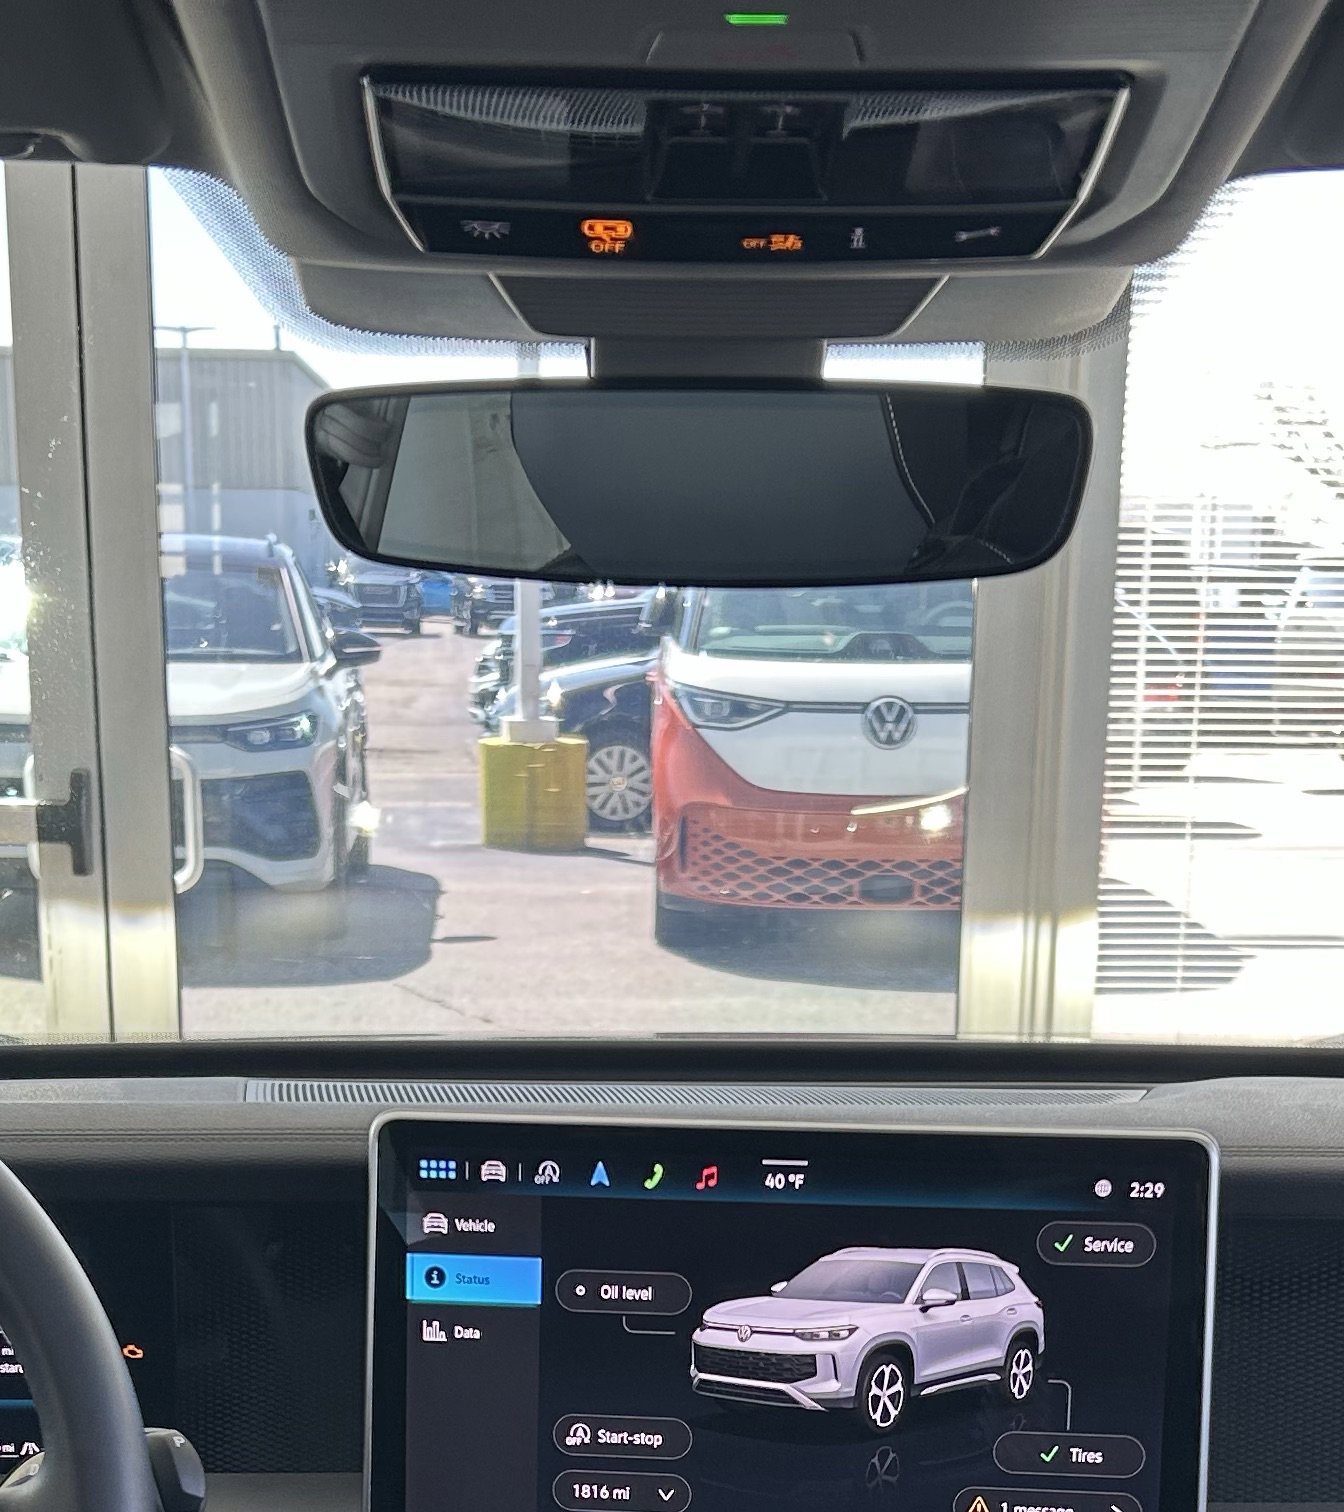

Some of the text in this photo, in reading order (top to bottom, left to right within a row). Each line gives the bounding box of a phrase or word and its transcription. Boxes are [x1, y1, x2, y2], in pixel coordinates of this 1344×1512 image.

[589, 240, 626, 253] OFF
[764, 1173, 786, 1190] 40
[1129, 1181, 1166, 1199] 2:29
[454, 1217, 496, 1233] Vehicle
[1083, 1236, 1135, 1254] Service
[455, 1272, 491, 1286] Status
[600, 1285, 653, 1301] Oil level
[454, 1325, 481, 1340] Data
[172, 1435, 186, 1448] P
[597, 1429, 663, 1448] Start-stop
[2, 1443, 15, 1453] mi
[1069, 1447, 1103, 1463] Tires
[572, 1484, 630, 1500] 1816 mi
